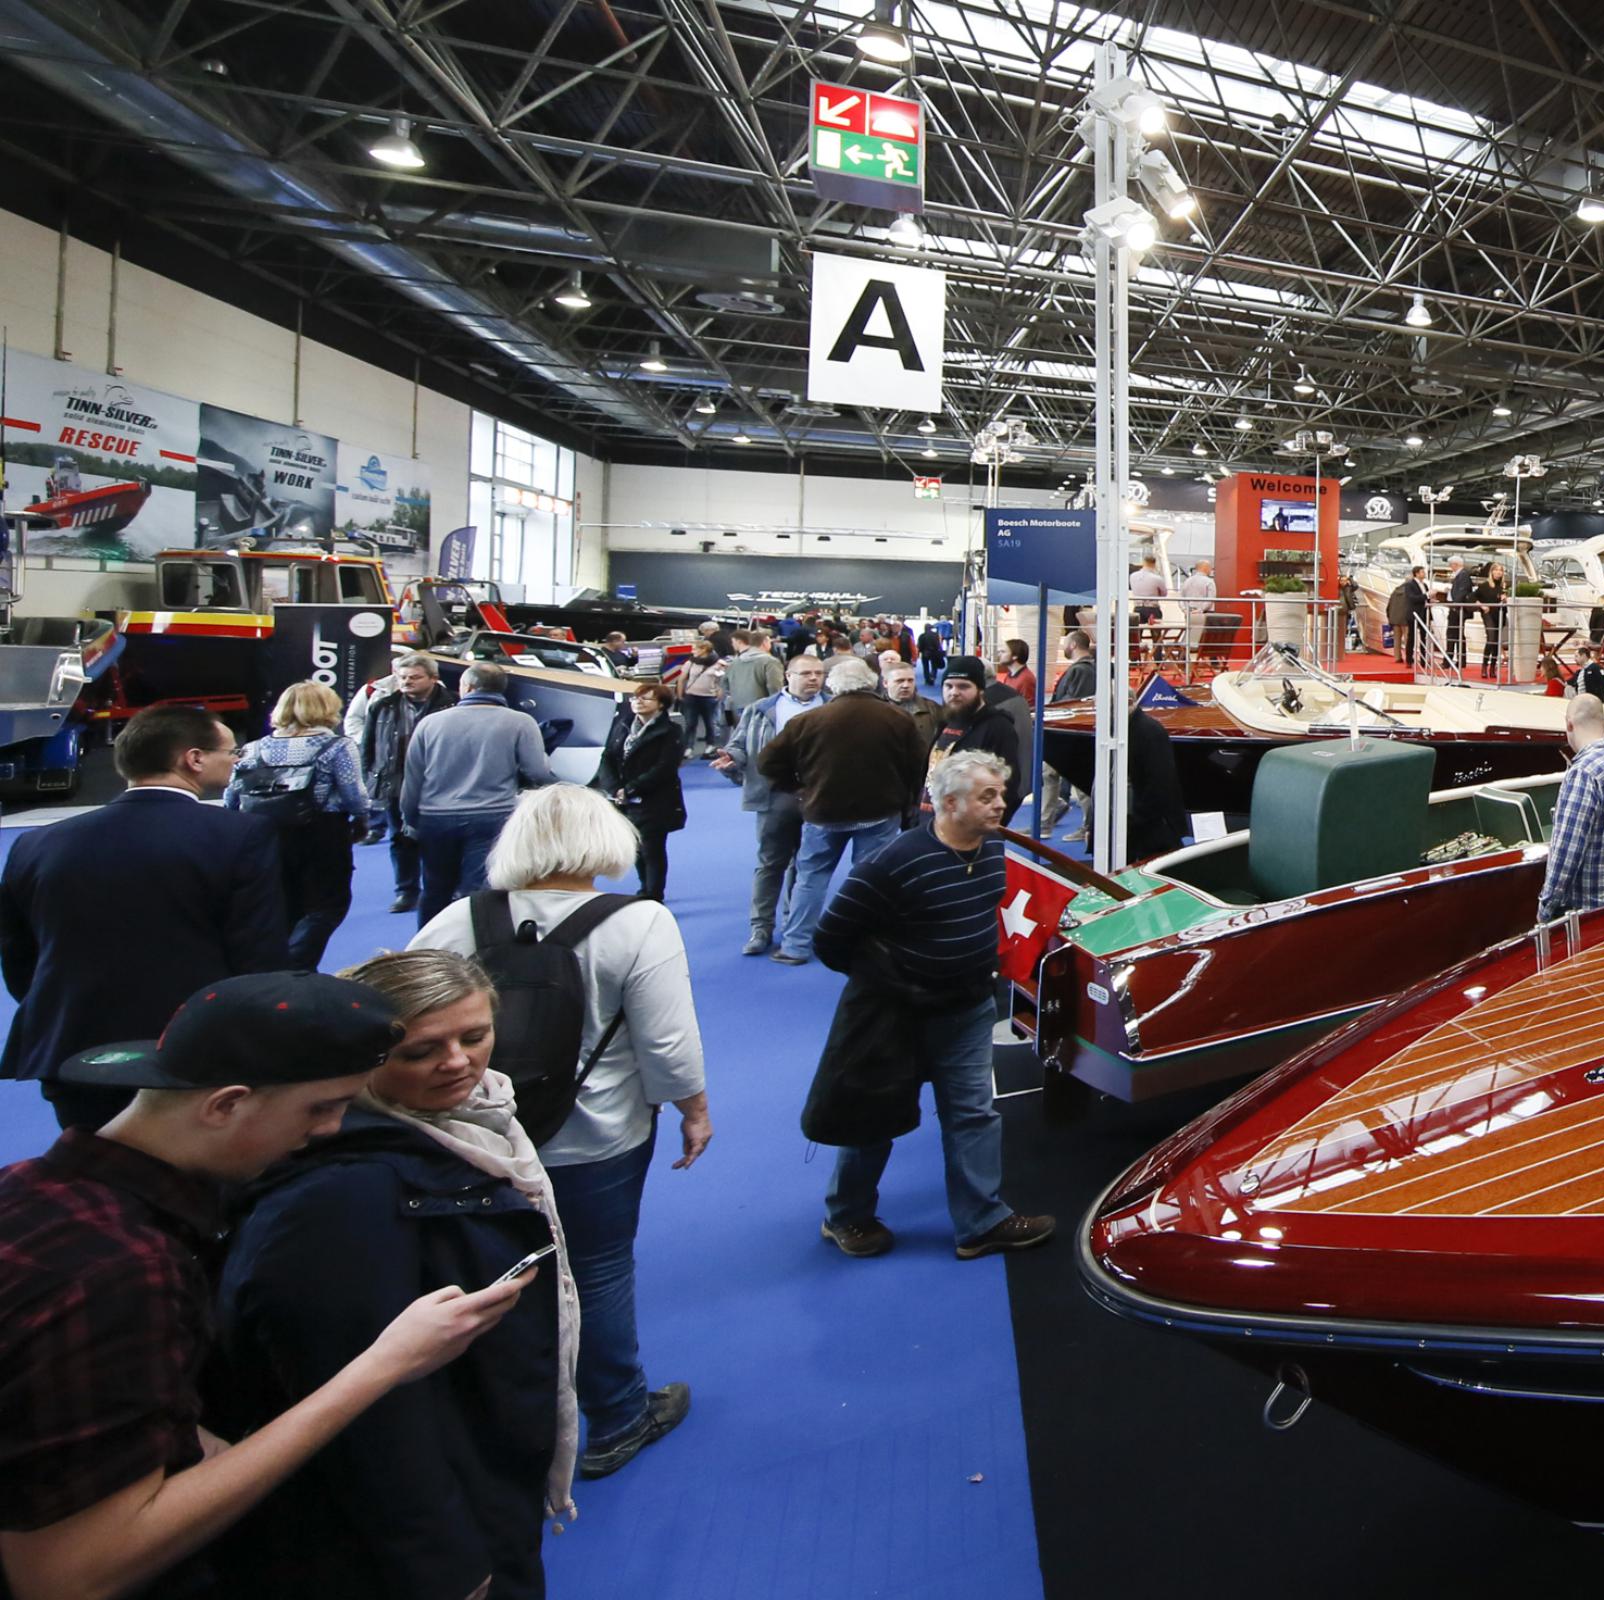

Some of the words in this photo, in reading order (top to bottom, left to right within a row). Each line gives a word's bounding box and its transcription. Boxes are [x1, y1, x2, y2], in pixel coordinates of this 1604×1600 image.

[826, 279, 925, 373] A
[58, 426, 142, 457] RESCUE
[274, 470, 314, 490] WORK
[1250, 478, 1328, 495] Welcome
[997, 529, 1011, 537] AG
[998, 519, 1028, 527] Boesch
[1030, 519, 1081, 527] Motorboote
[347, 645, 356, 689] GENERATION
